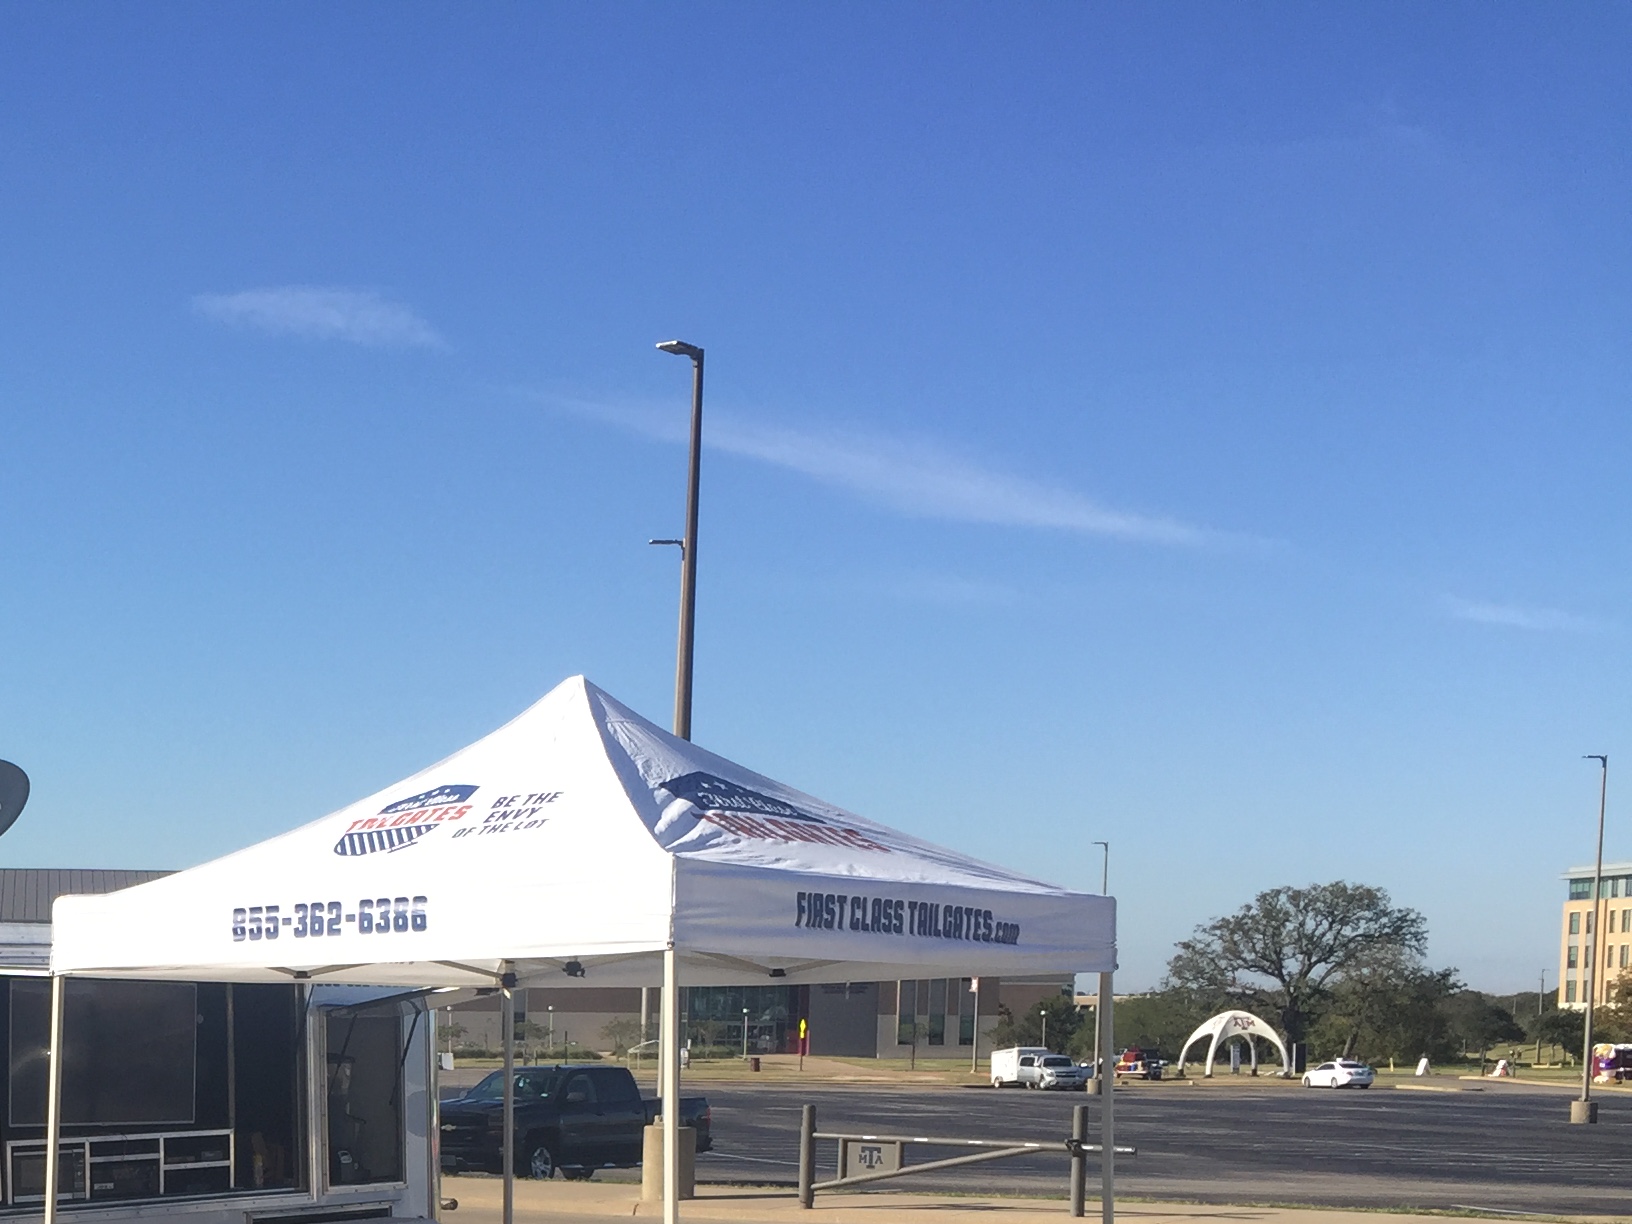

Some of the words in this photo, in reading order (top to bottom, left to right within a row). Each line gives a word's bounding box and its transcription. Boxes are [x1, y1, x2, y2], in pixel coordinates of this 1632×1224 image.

[490, 794, 521, 809] BE
[522, 791, 564, 806] THE
[483, 807, 543, 823] ENVY
[451, 826, 477, 839] OF
[478, 822, 513, 836] THE
[513, 818, 550, 831] LOT
[232, 895, 428, 942] 855-362-6386
[794, 891, 848, 931] FIRST
[849, 895, 904, 935] CLASS
[906, 901, 1020, 945] TAILGATES.com
